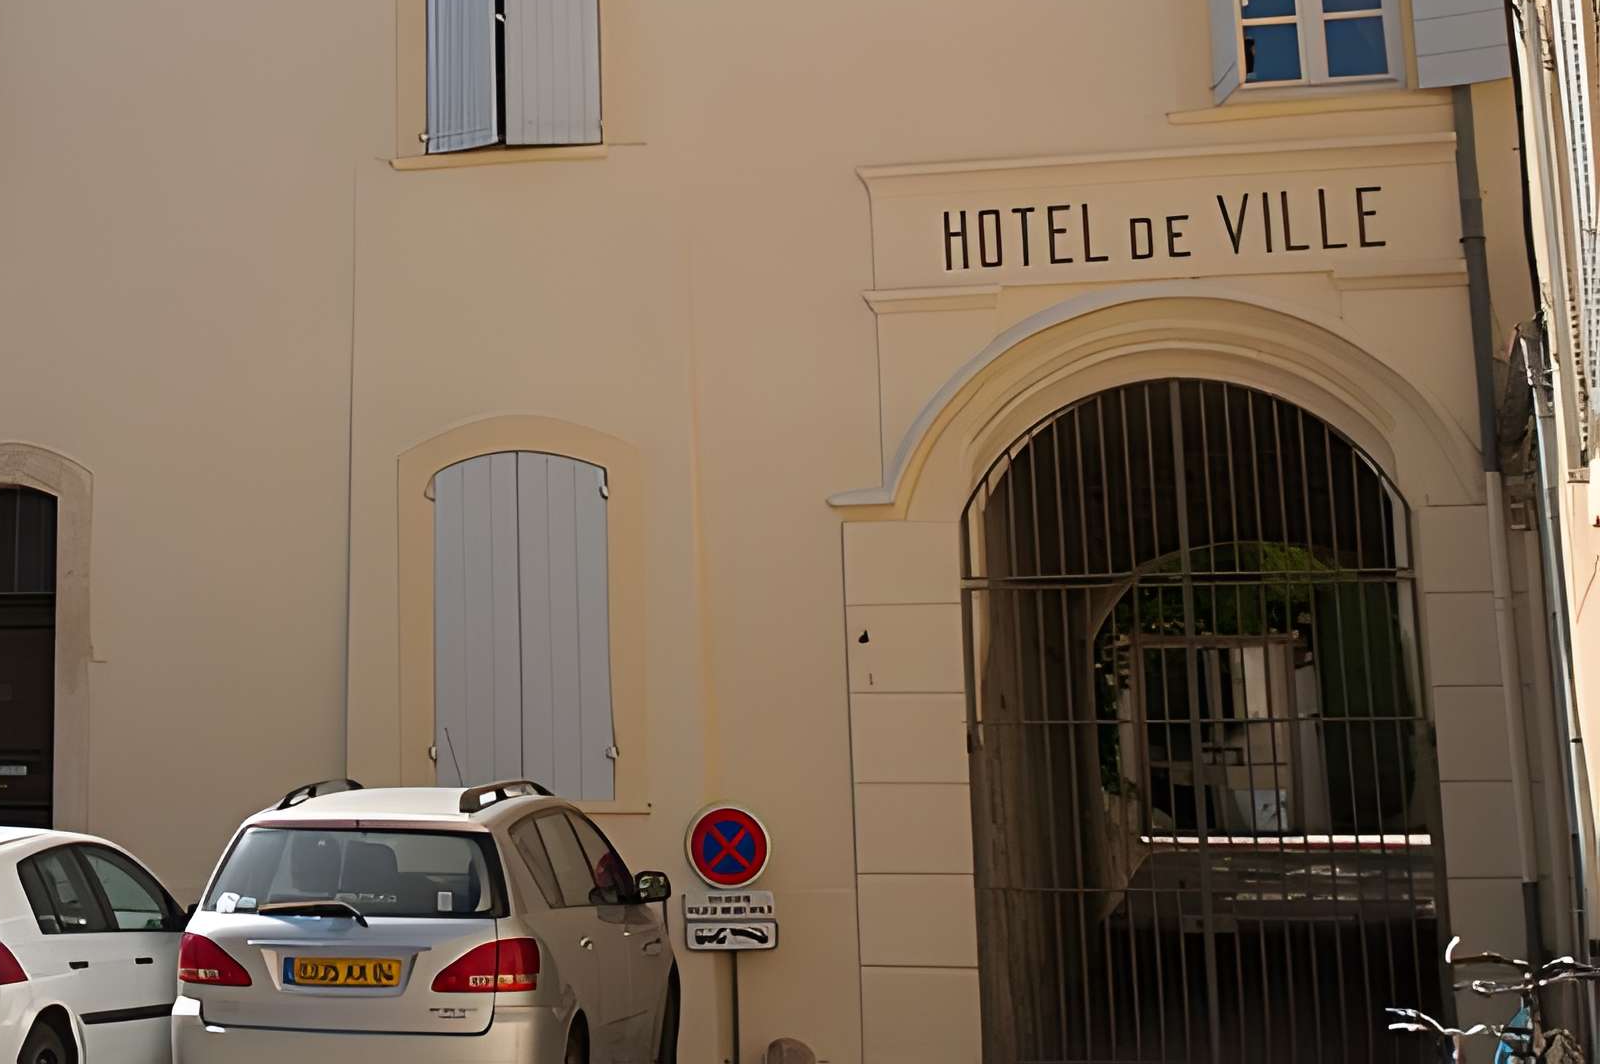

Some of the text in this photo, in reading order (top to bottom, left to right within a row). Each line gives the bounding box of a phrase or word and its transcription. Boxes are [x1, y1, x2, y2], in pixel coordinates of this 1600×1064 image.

[943, 186, 1386, 271] HOTEL DE VILLE
